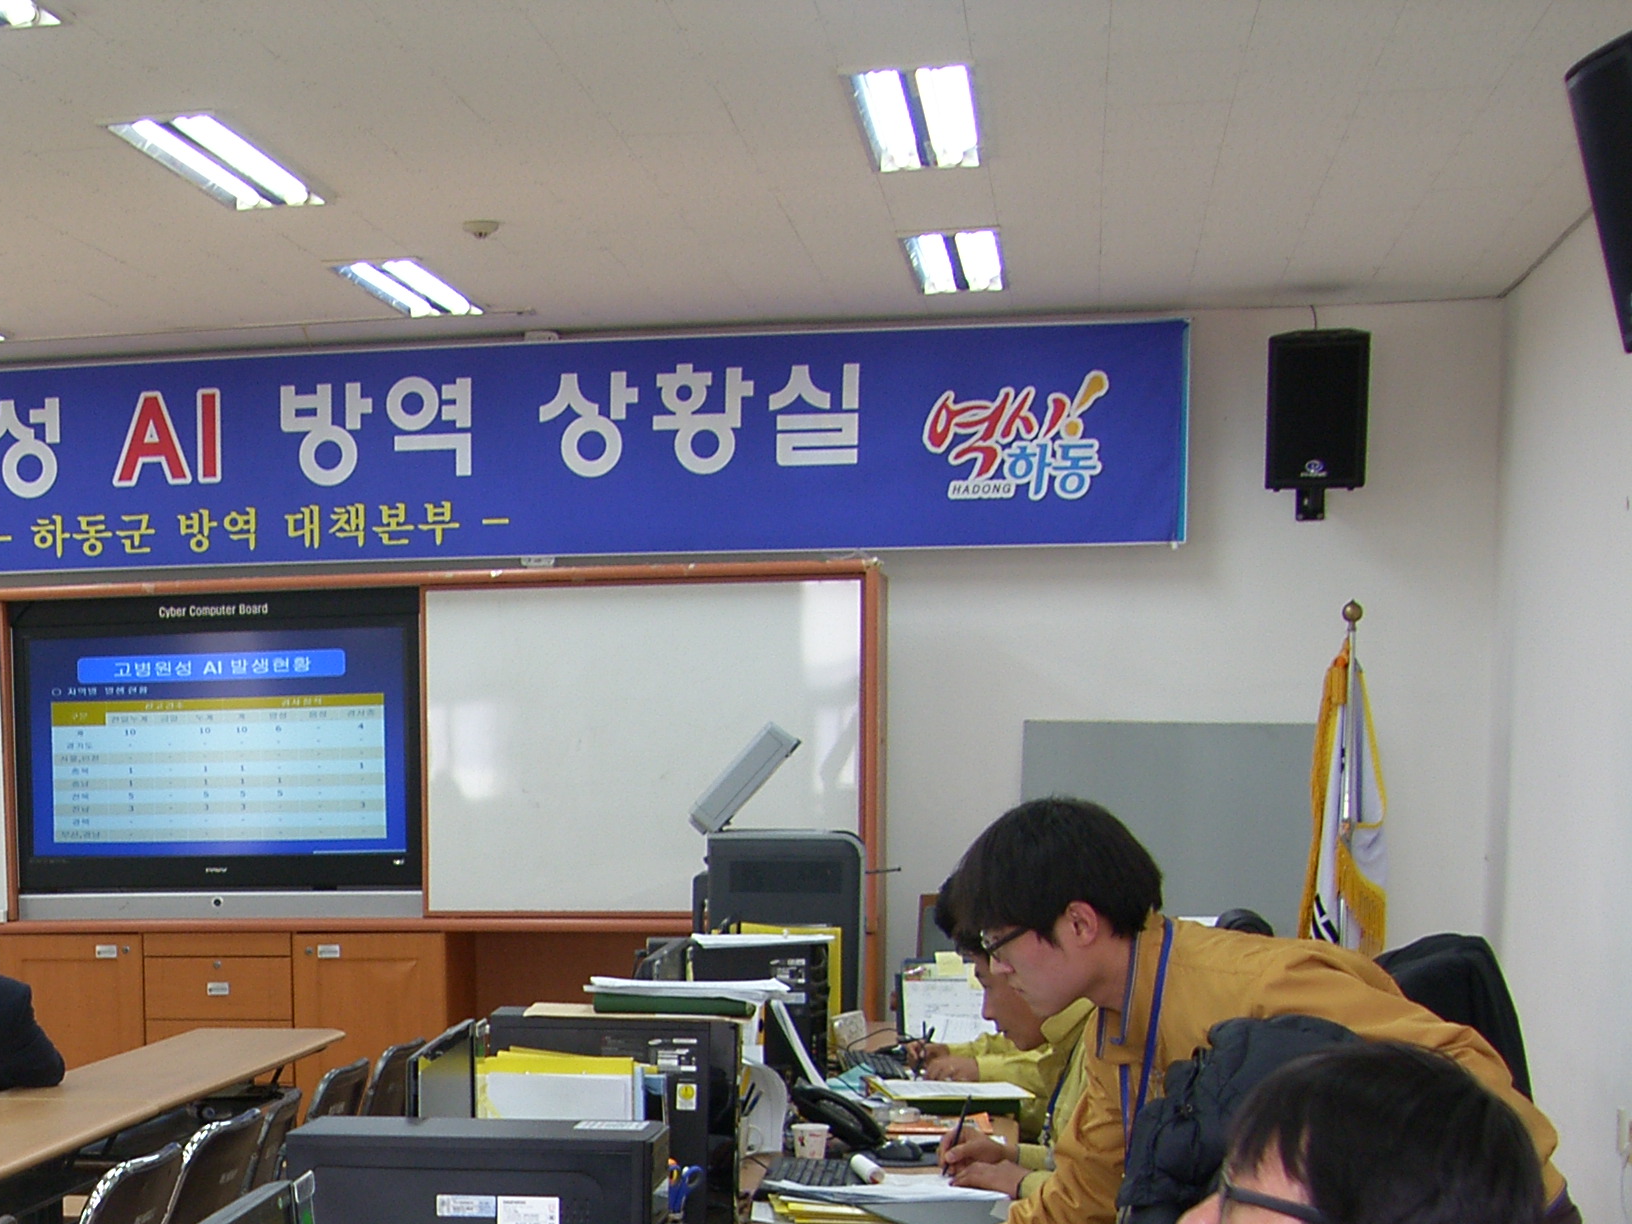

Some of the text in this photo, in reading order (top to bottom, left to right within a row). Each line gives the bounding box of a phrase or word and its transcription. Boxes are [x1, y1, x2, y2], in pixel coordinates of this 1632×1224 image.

[112, 388, 222, 488] AI
[279, 373, 473, 487] 방역
[538, 361, 863, 479] 상황실
[1002, 442, 1102, 500] 하동
[950, 482, 1014, 498] HADONG
[29, 514, 156, 560] 하동군
[178, 506, 259, 554] 방역
[283, 500, 462, 550] 대책본부
[158, 603, 269, 618] Cyber Computer Board
[113, 660, 193, 678] 고병원성
[202, 661, 223, 675] AI
[124, 729, 137, 737] 10
[199, 727, 212, 735] 10
[235, 726, 248, 734] 10
